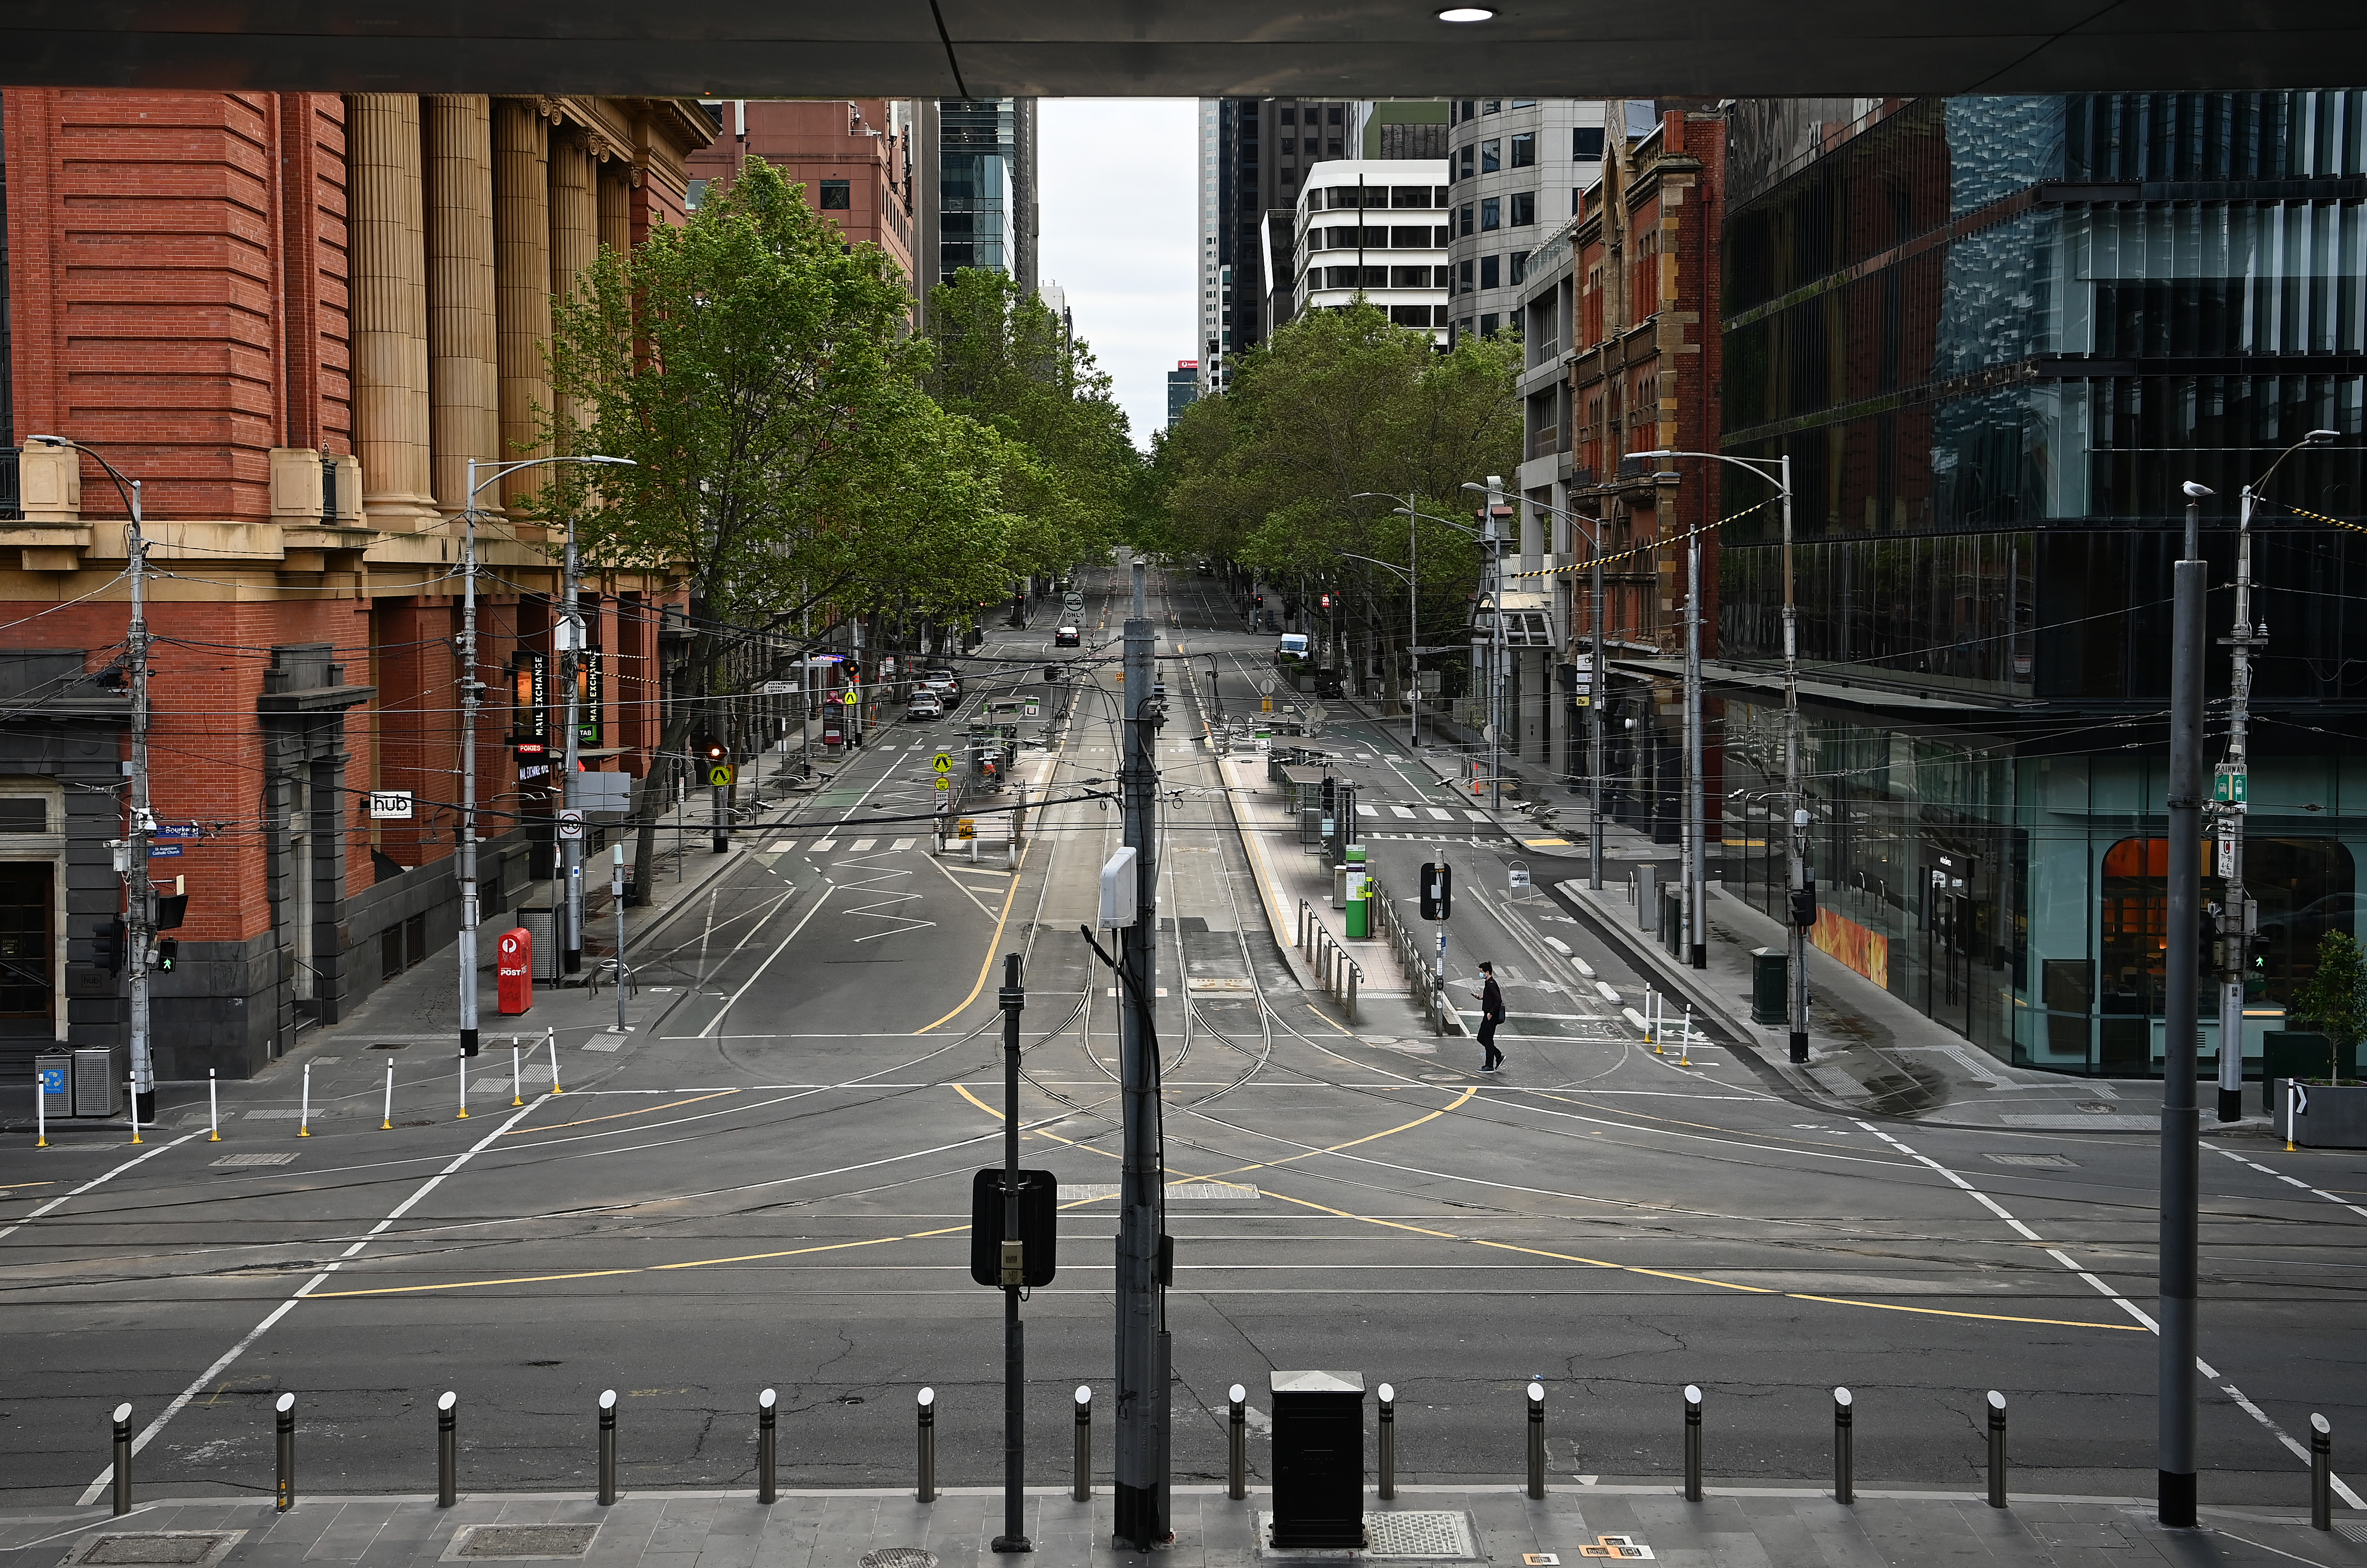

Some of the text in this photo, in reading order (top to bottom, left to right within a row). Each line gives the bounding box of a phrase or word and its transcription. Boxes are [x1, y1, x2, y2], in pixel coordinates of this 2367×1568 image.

[2217, 765, 2244, 774] AIRWAY
[374, 794, 407, 811] hub
[84, 976, 99, 984] hub
